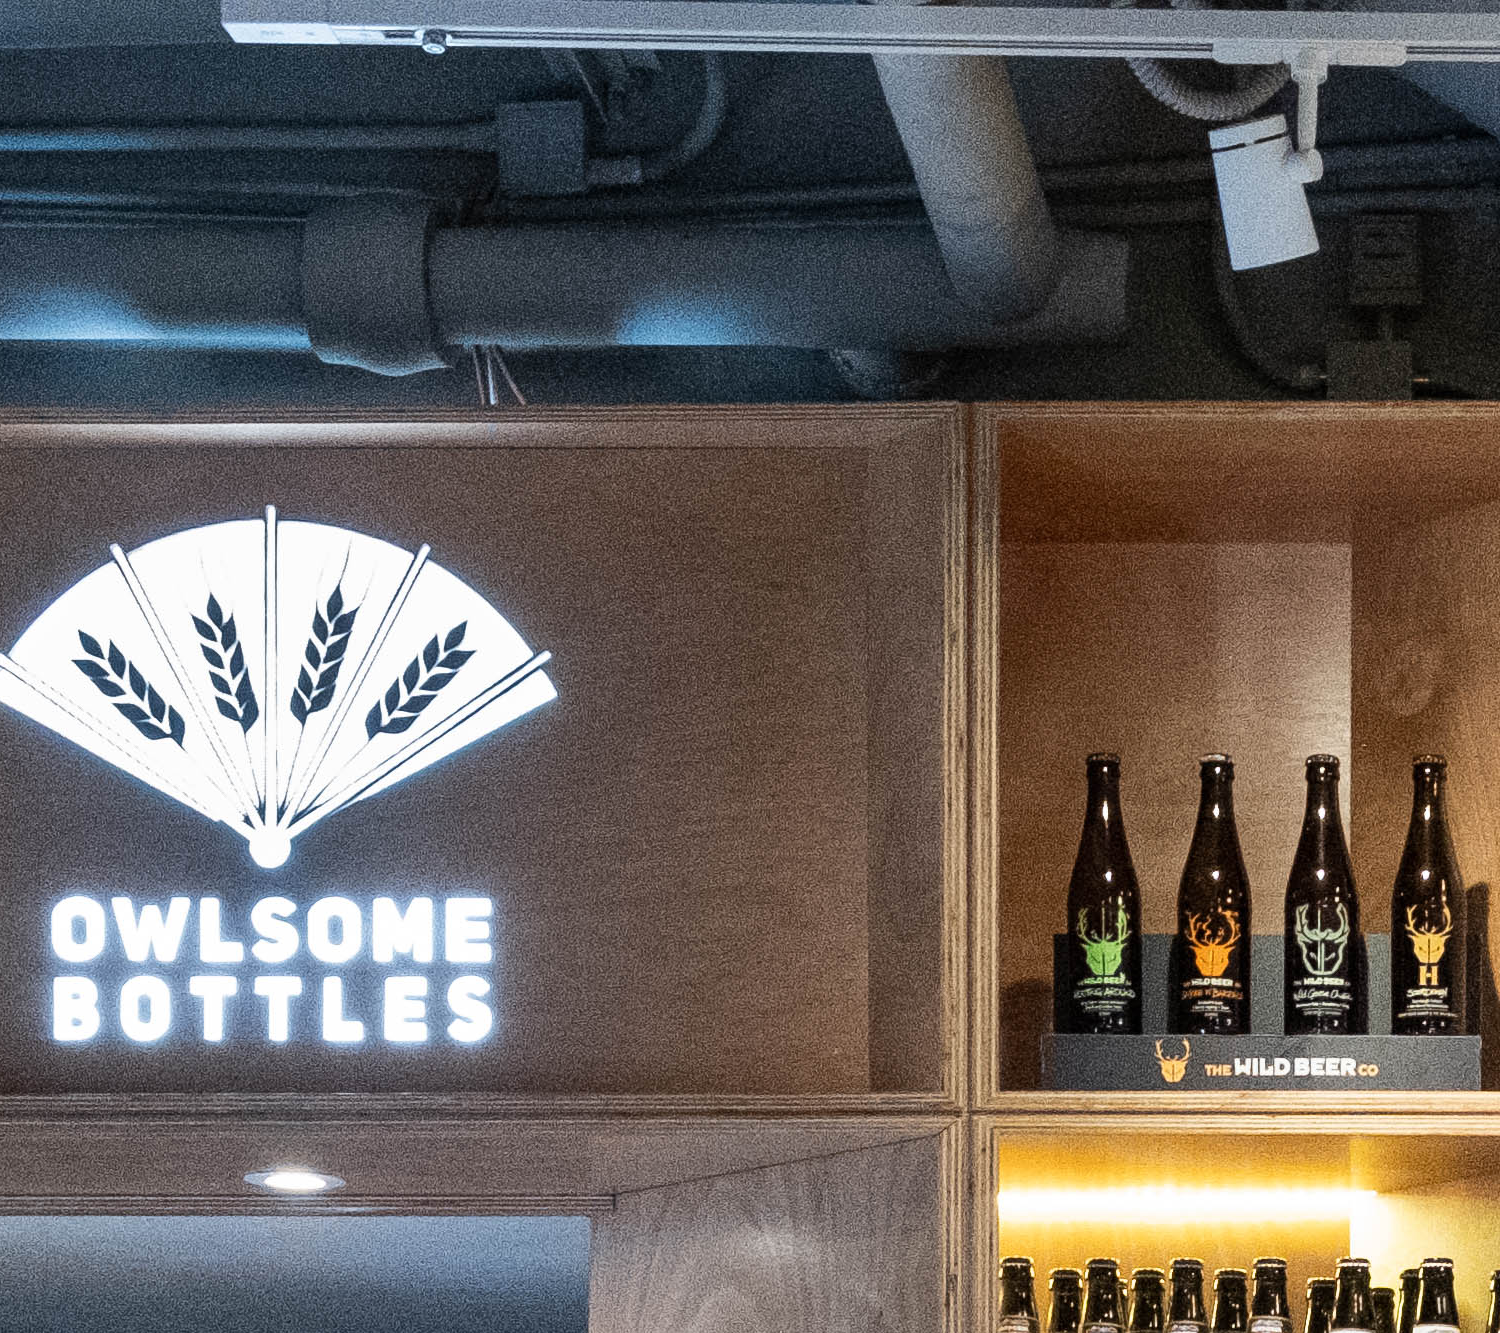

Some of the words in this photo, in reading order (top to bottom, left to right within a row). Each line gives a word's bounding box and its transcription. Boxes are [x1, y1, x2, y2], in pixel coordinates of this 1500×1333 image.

[51, 897, 492, 963] OWLSOME
[52, 976, 492, 1042] BOTTLES
[1205, 1064, 1232, 1076] THE
[1234, 1058, 1290, 1076] WILD
[1294, 1058, 1356, 1076] BEER
[1356, 1064, 1378, 1077] CO
